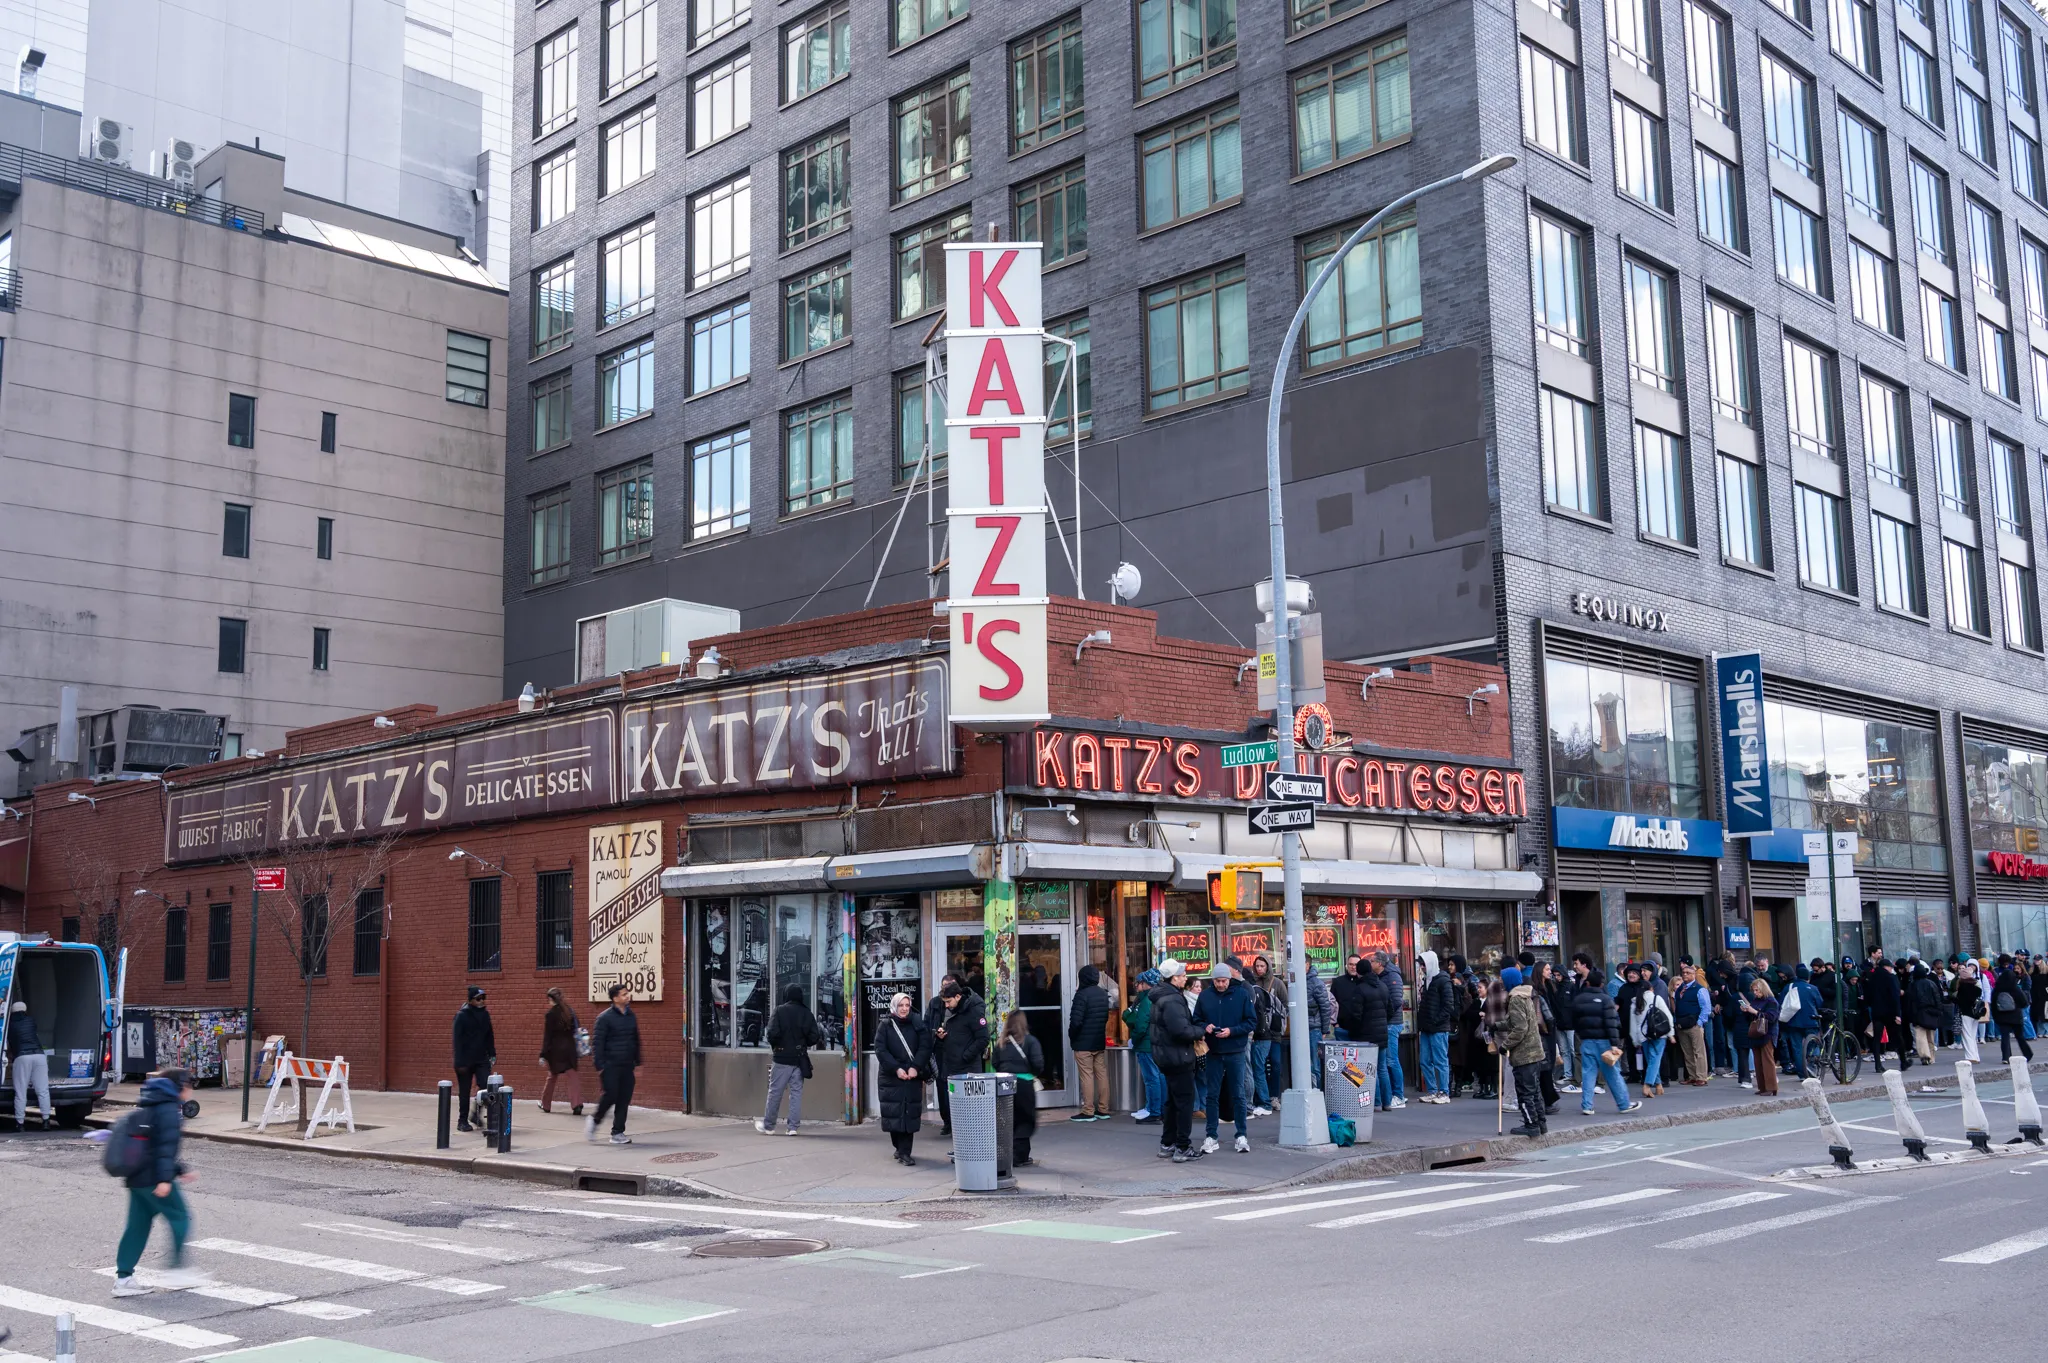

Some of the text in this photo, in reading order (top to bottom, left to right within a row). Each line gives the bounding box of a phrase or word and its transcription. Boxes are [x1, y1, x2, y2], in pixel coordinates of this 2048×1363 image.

[962, 250, 1025, 701] KATZ'S
[1575, 592, 1669, 633] EQUINOX
[1261, 662, 1276, 671] TATTOO
[629, 700, 851, 793] KATZ'S
[1223, 743, 1278, 766] Ludlow St
[1726, 669, 1764, 818] Marshalls
[1036, 731, 1201, 797] KATZ'S
[465, 766, 592, 807] DELICATESSEN
[1275, 781, 1319, 795] ONE WAY
[279, 760, 449, 841] KATZ'S
[1261, 811, 1308, 826] ONE WAY
[178, 818, 263, 849] WURST FABRIC
[1608, 815, 1689, 851] Marshalls
[592, 829, 658, 862] KATZ'S
[2004, 853, 2026, 877] CVS
[591, 874, 660, 942] DELICATESSEN
[617, 931, 653, 946] KNOWN
[1232, 934, 1267, 952] KATZ'S
[1730, 932, 1750, 942] Marshalls
[599, 947, 648, 964] as the Best
[617, 972, 657, 994] 1898
[865, 983, 917, 994] The Real Taste
[868, 992, 876, 1002] of
